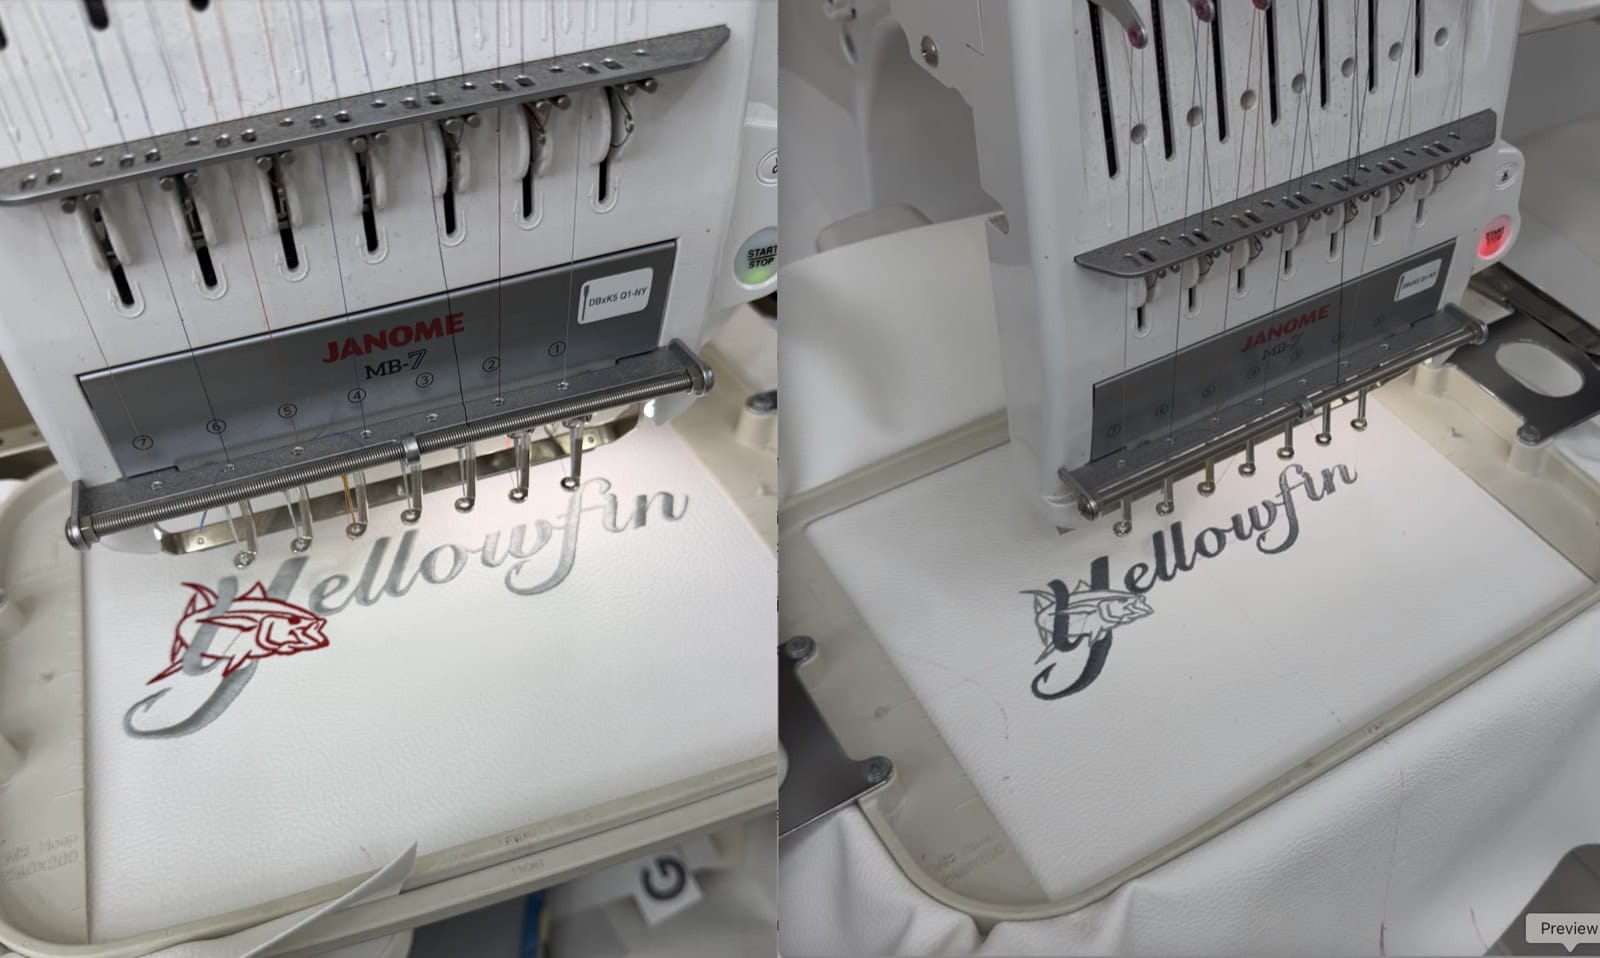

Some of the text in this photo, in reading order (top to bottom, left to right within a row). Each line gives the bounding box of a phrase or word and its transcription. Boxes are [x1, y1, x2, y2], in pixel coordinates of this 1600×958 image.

[747, 245, 778, 259] START
[748, 256, 776, 270] STOP
[620, 286, 649, 300] Q1-NY
[322, 311, 466, 364] JANOME
[1240, 304, 1331, 353] JANOME
[364, 348, 428, 380] MB-7
